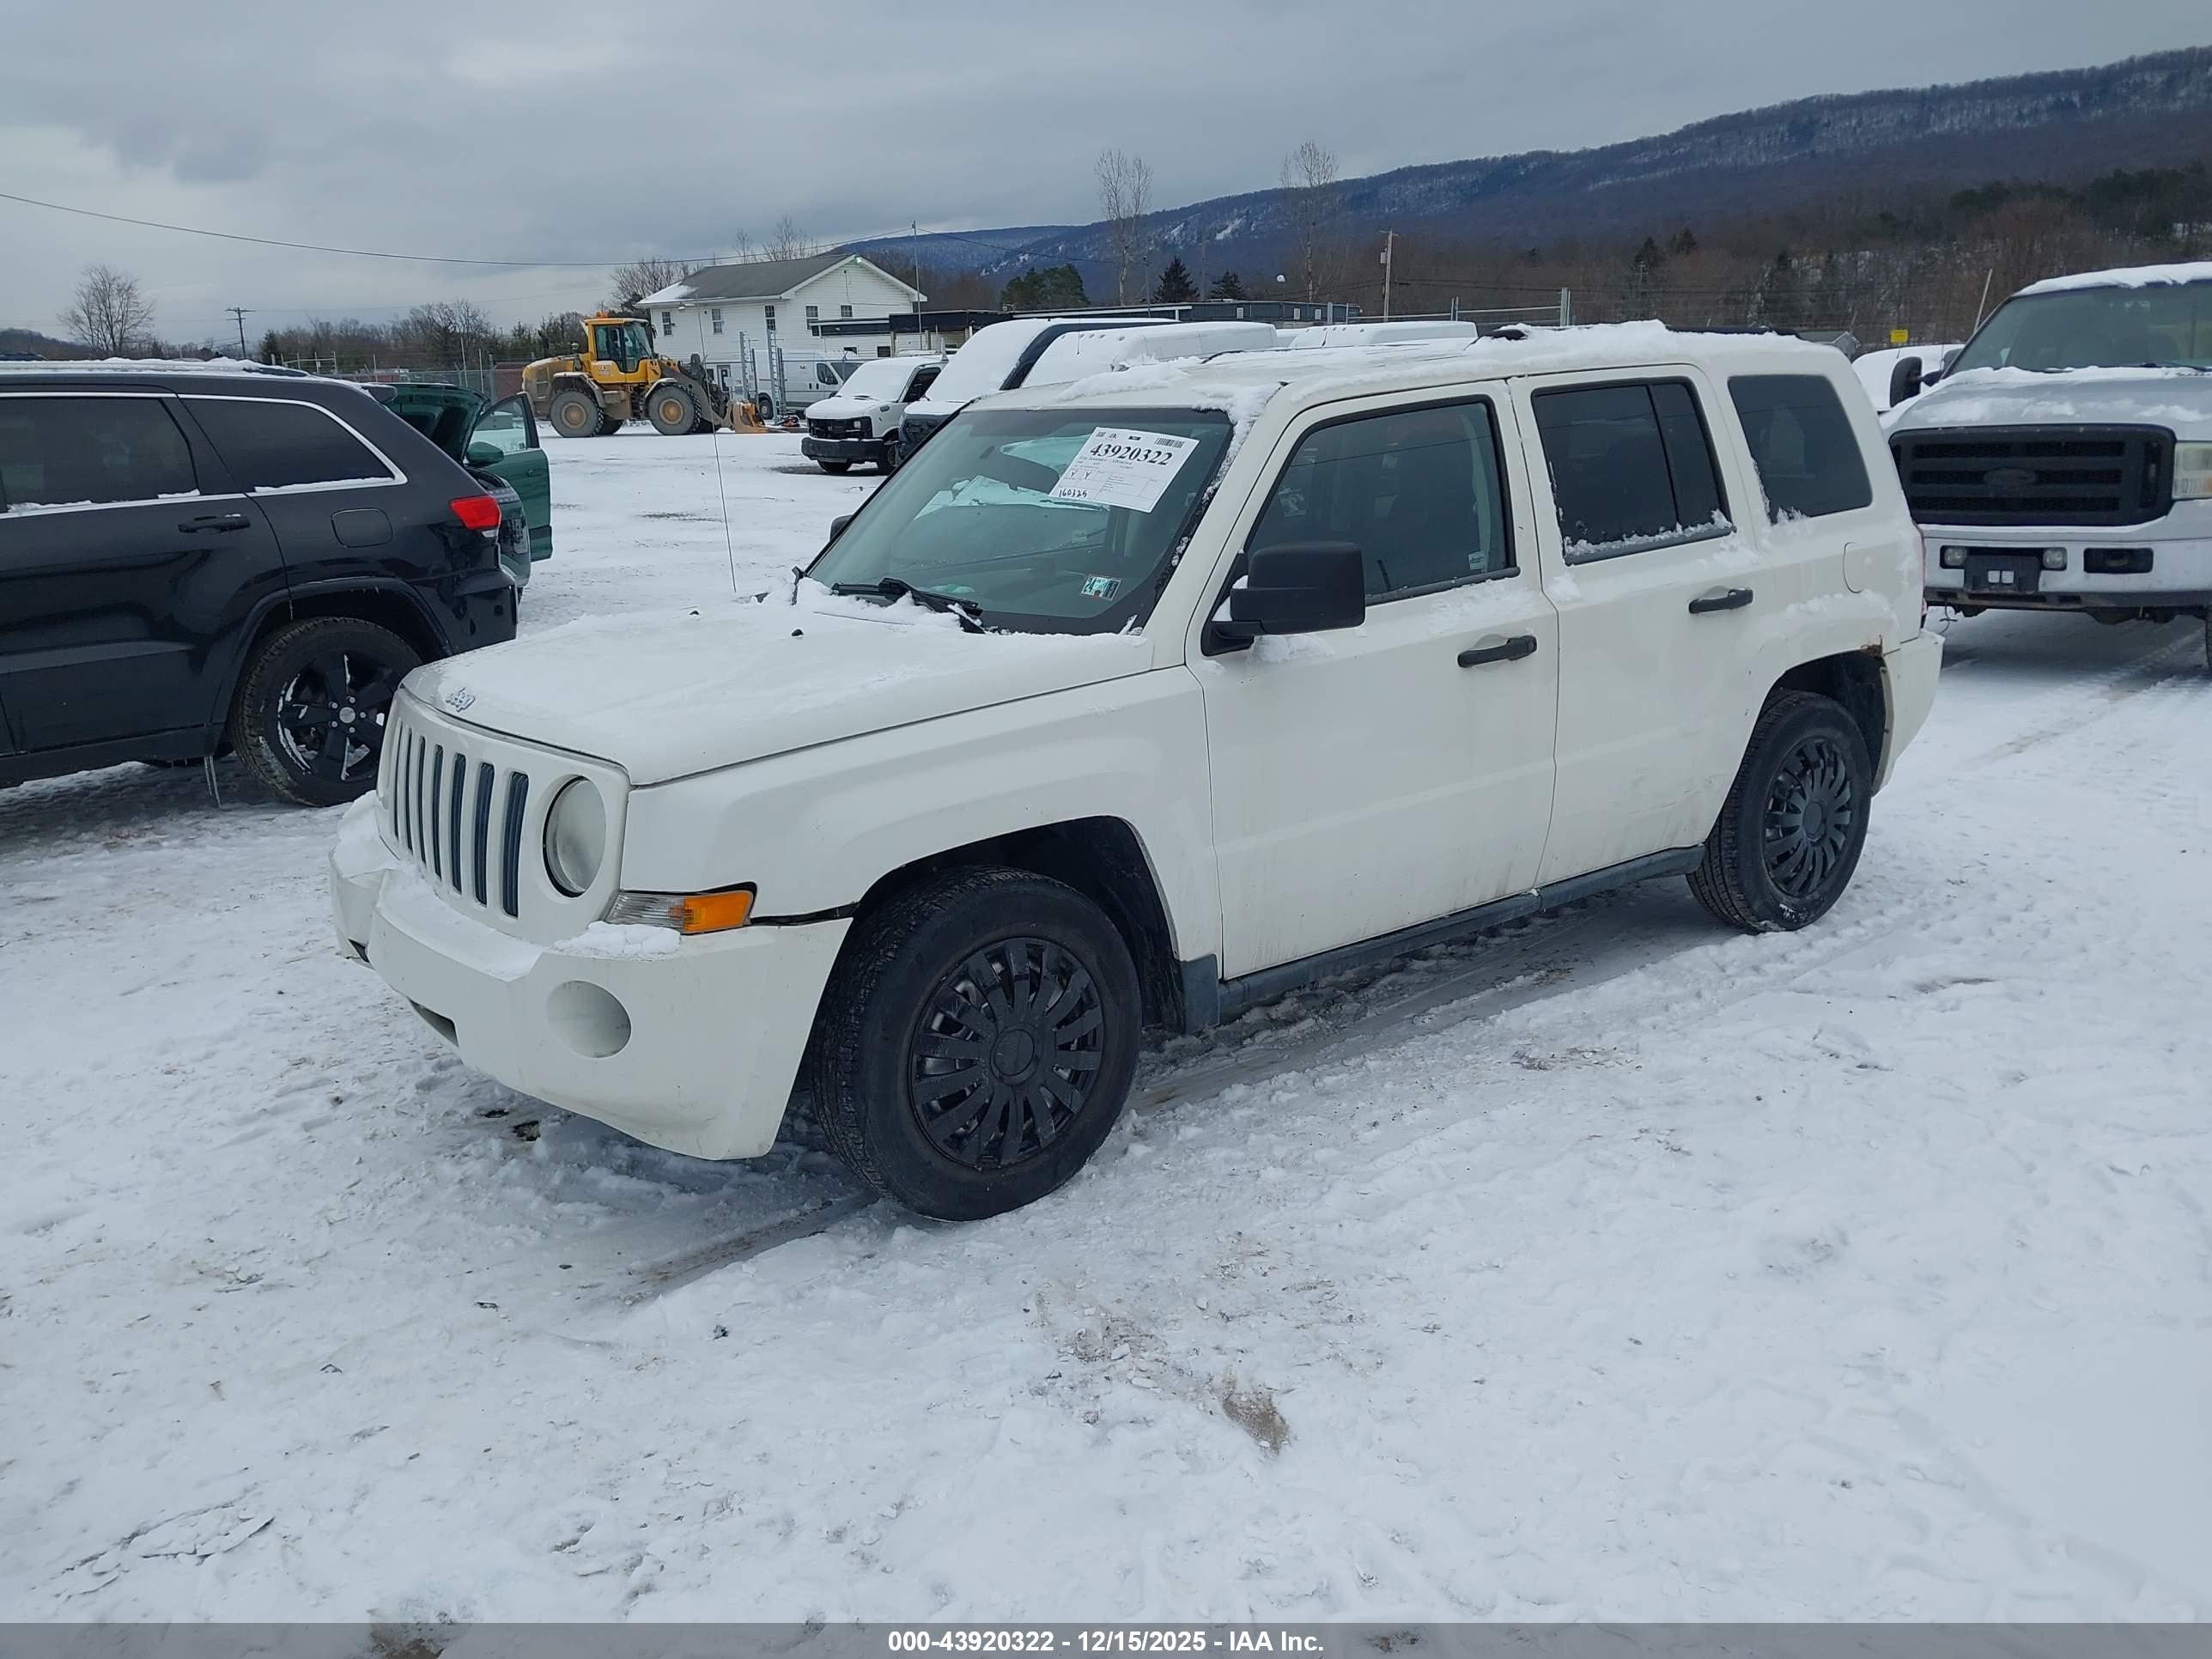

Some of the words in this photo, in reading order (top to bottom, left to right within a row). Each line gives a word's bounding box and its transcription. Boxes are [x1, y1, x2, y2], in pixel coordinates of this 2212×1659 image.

[1090, 442, 1173, 466] 43920322
[1084, 577, 1097, 592] 24
[445, 687, 476, 713] Jeep
